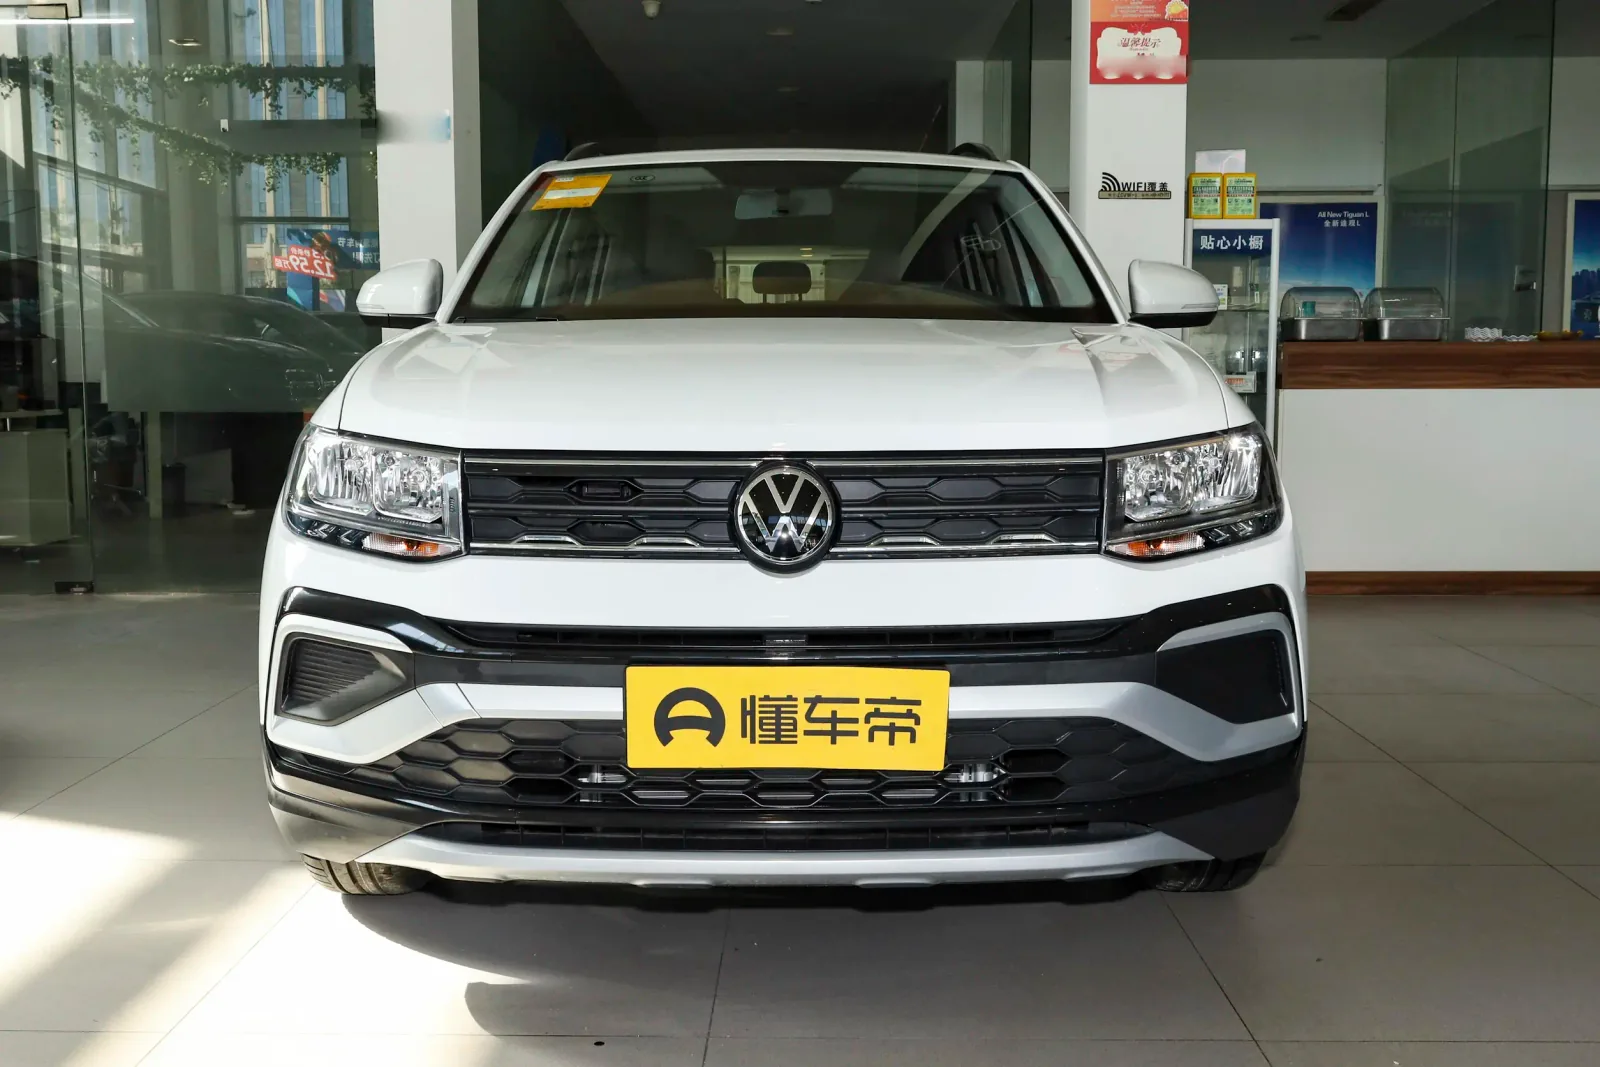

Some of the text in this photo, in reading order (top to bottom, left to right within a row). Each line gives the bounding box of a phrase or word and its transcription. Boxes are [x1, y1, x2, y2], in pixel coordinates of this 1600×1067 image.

[1119, 37, 1161, 48] 温馨提示
[1343, 211, 1365, 219] Tiguan
[1200, 235, 1263, 250] 贴心小橱
[740, 694, 922, 746] 懂车帝
